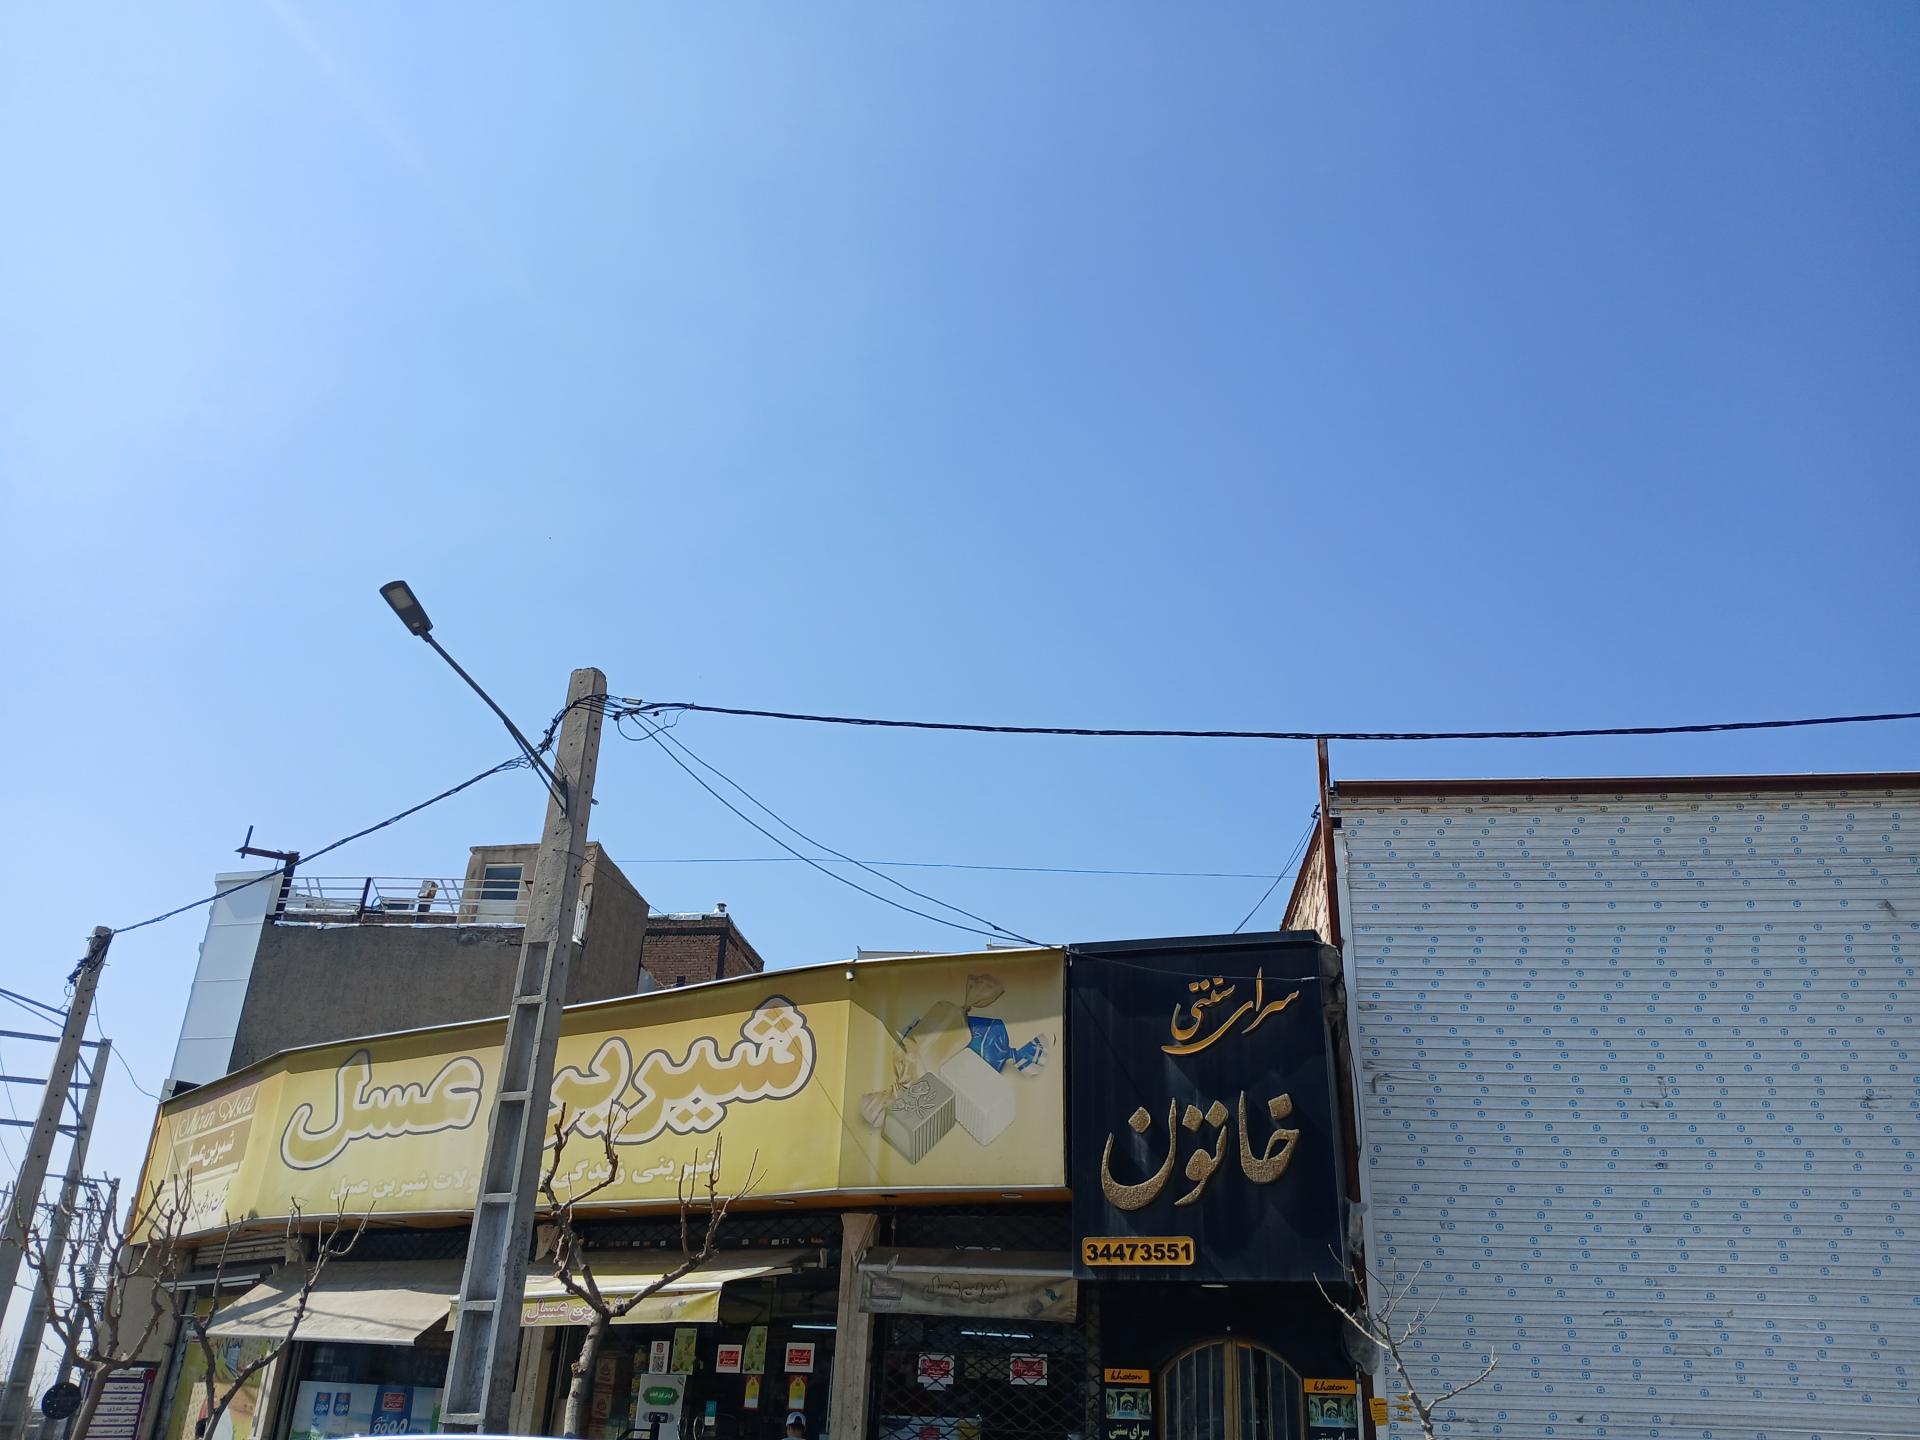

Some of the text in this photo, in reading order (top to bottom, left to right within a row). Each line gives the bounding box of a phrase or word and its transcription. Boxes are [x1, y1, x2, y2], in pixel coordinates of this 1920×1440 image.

[1161, 966, 1299, 1055] سرای سنتی
[279, 994, 817, 1171] شیری عسل
[1101, 1089, 1300, 1211] خاتون
[631, 1150, 721, 1184] شیرینی
[329, 1175, 369, 1201] عسل
[372, 1172, 429, 1200] شیرین
[1086, 1242, 1192, 1263] 34473551
[523, 1297, 569, 1324] عسل
